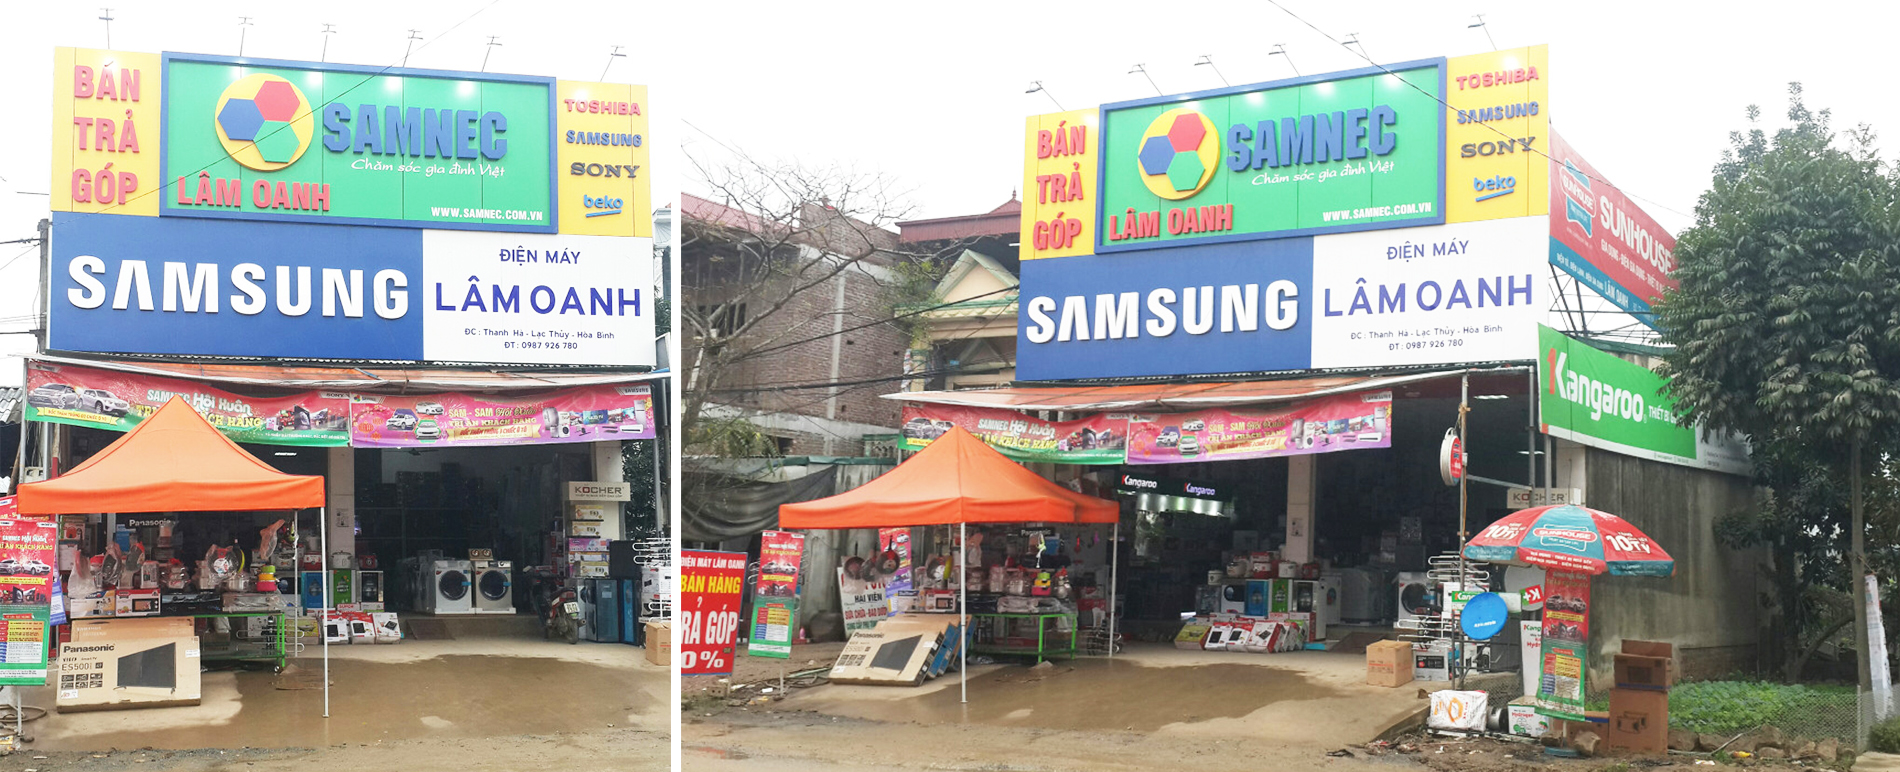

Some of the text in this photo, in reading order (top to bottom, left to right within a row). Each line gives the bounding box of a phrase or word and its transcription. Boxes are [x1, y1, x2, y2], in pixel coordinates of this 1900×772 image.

[74, 61, 140, 102] BÁN
[1456, 66, 1539, 90] TOSHIBA
[565, 99, 641, 116] TOSHIBA
[1457, 101, 1539, 124] SAMSUNG
[74, 109, 140, 153] TRẢ
[323, 102, 508, 160] SAMNEC
[566, 130, 642, 147] SAMSUNG
[1037, 120, 1086, 159] BÁN
[1226, 104, 1397, 172] SAMNEC
[1461, 136, 1536, 158] SONY
[351, 158, 506, 178] Chăm sóc gia đình Việt
[570, 161, 640, 178] SONY
[1252, 160, 1395, 186] Chăm sóc gia đình Việt
[72, 162, 138, 205] GÓP
[178, 171, 330, 211] LÂM OANH
[1036, 162, 1083, 204] TRẢ
[1473, 175, 1516, 192] beko
[1563, 175, 1594, 210] SUNHOUSE
[583, 194, 624, 210] beko
[1322, 202, 1432, 222] WWW.SAMNEC.COM.VN
[431, 207, 543, 221] WWW.SAMNEC.COM.VN
[1109, 204, 1233, 241] LÂM OANH
[1032, 212, 1082, 250] GÓP
[1600, 195, 1673, 276] SUNHOUSE
[499, 245, 581, 266] ĐIỆN MÁY
[1387, 238, 1469, 262] ĐIỆN MÁY
[67, 255, 409, 320] SAMSUNG
[436, 275, 641, 317] LÂM OANH
[1324, 274, 1532, 317] LÂM OANH
[1026, 279, 1299, 344] SAMSUNG
[483, 329, 508, 337] Thanh
[531, 330, 546, 339] Lạc
[1369, 331, 1393, 339] Thanh
[1416, 329, 1430, 338] Lạc
[1406, 341, 1426, 350] 0987
[1429, 340, 1445, 348] 926
[1448, 339, 1463, 347] 780
[545, 342, 560, 350] 926
[563, 342, 578, 350] 780
[1547, 348, 1644, 422] Kangaroo
[1648, 404, 1663, 420] THIẾT
[449, 409, 466, 417] SAM
[474, 408, 493, 417] SAM
[978, 418, 1009, 431] SAMNEC
[575, 486, 622, 494] KOCHER
[1122, 475, 1157, 488] Kangaroo
[1184, 482, 1215, 496] Kangaroo
[1539, 530, 1591, 539] SUNHOUSE
[697, 556, 713, 568] MÁY
[713, 557, 727, 569] LÂM
[727, 560, 746, 569] OANH
[681, 571, 741, 594] BÁN HÀNG
[681, 596, 702, 645] RẢ
[705, 604, 738, 645] GÓP
[63, 644, 115, 653] Panasonic
